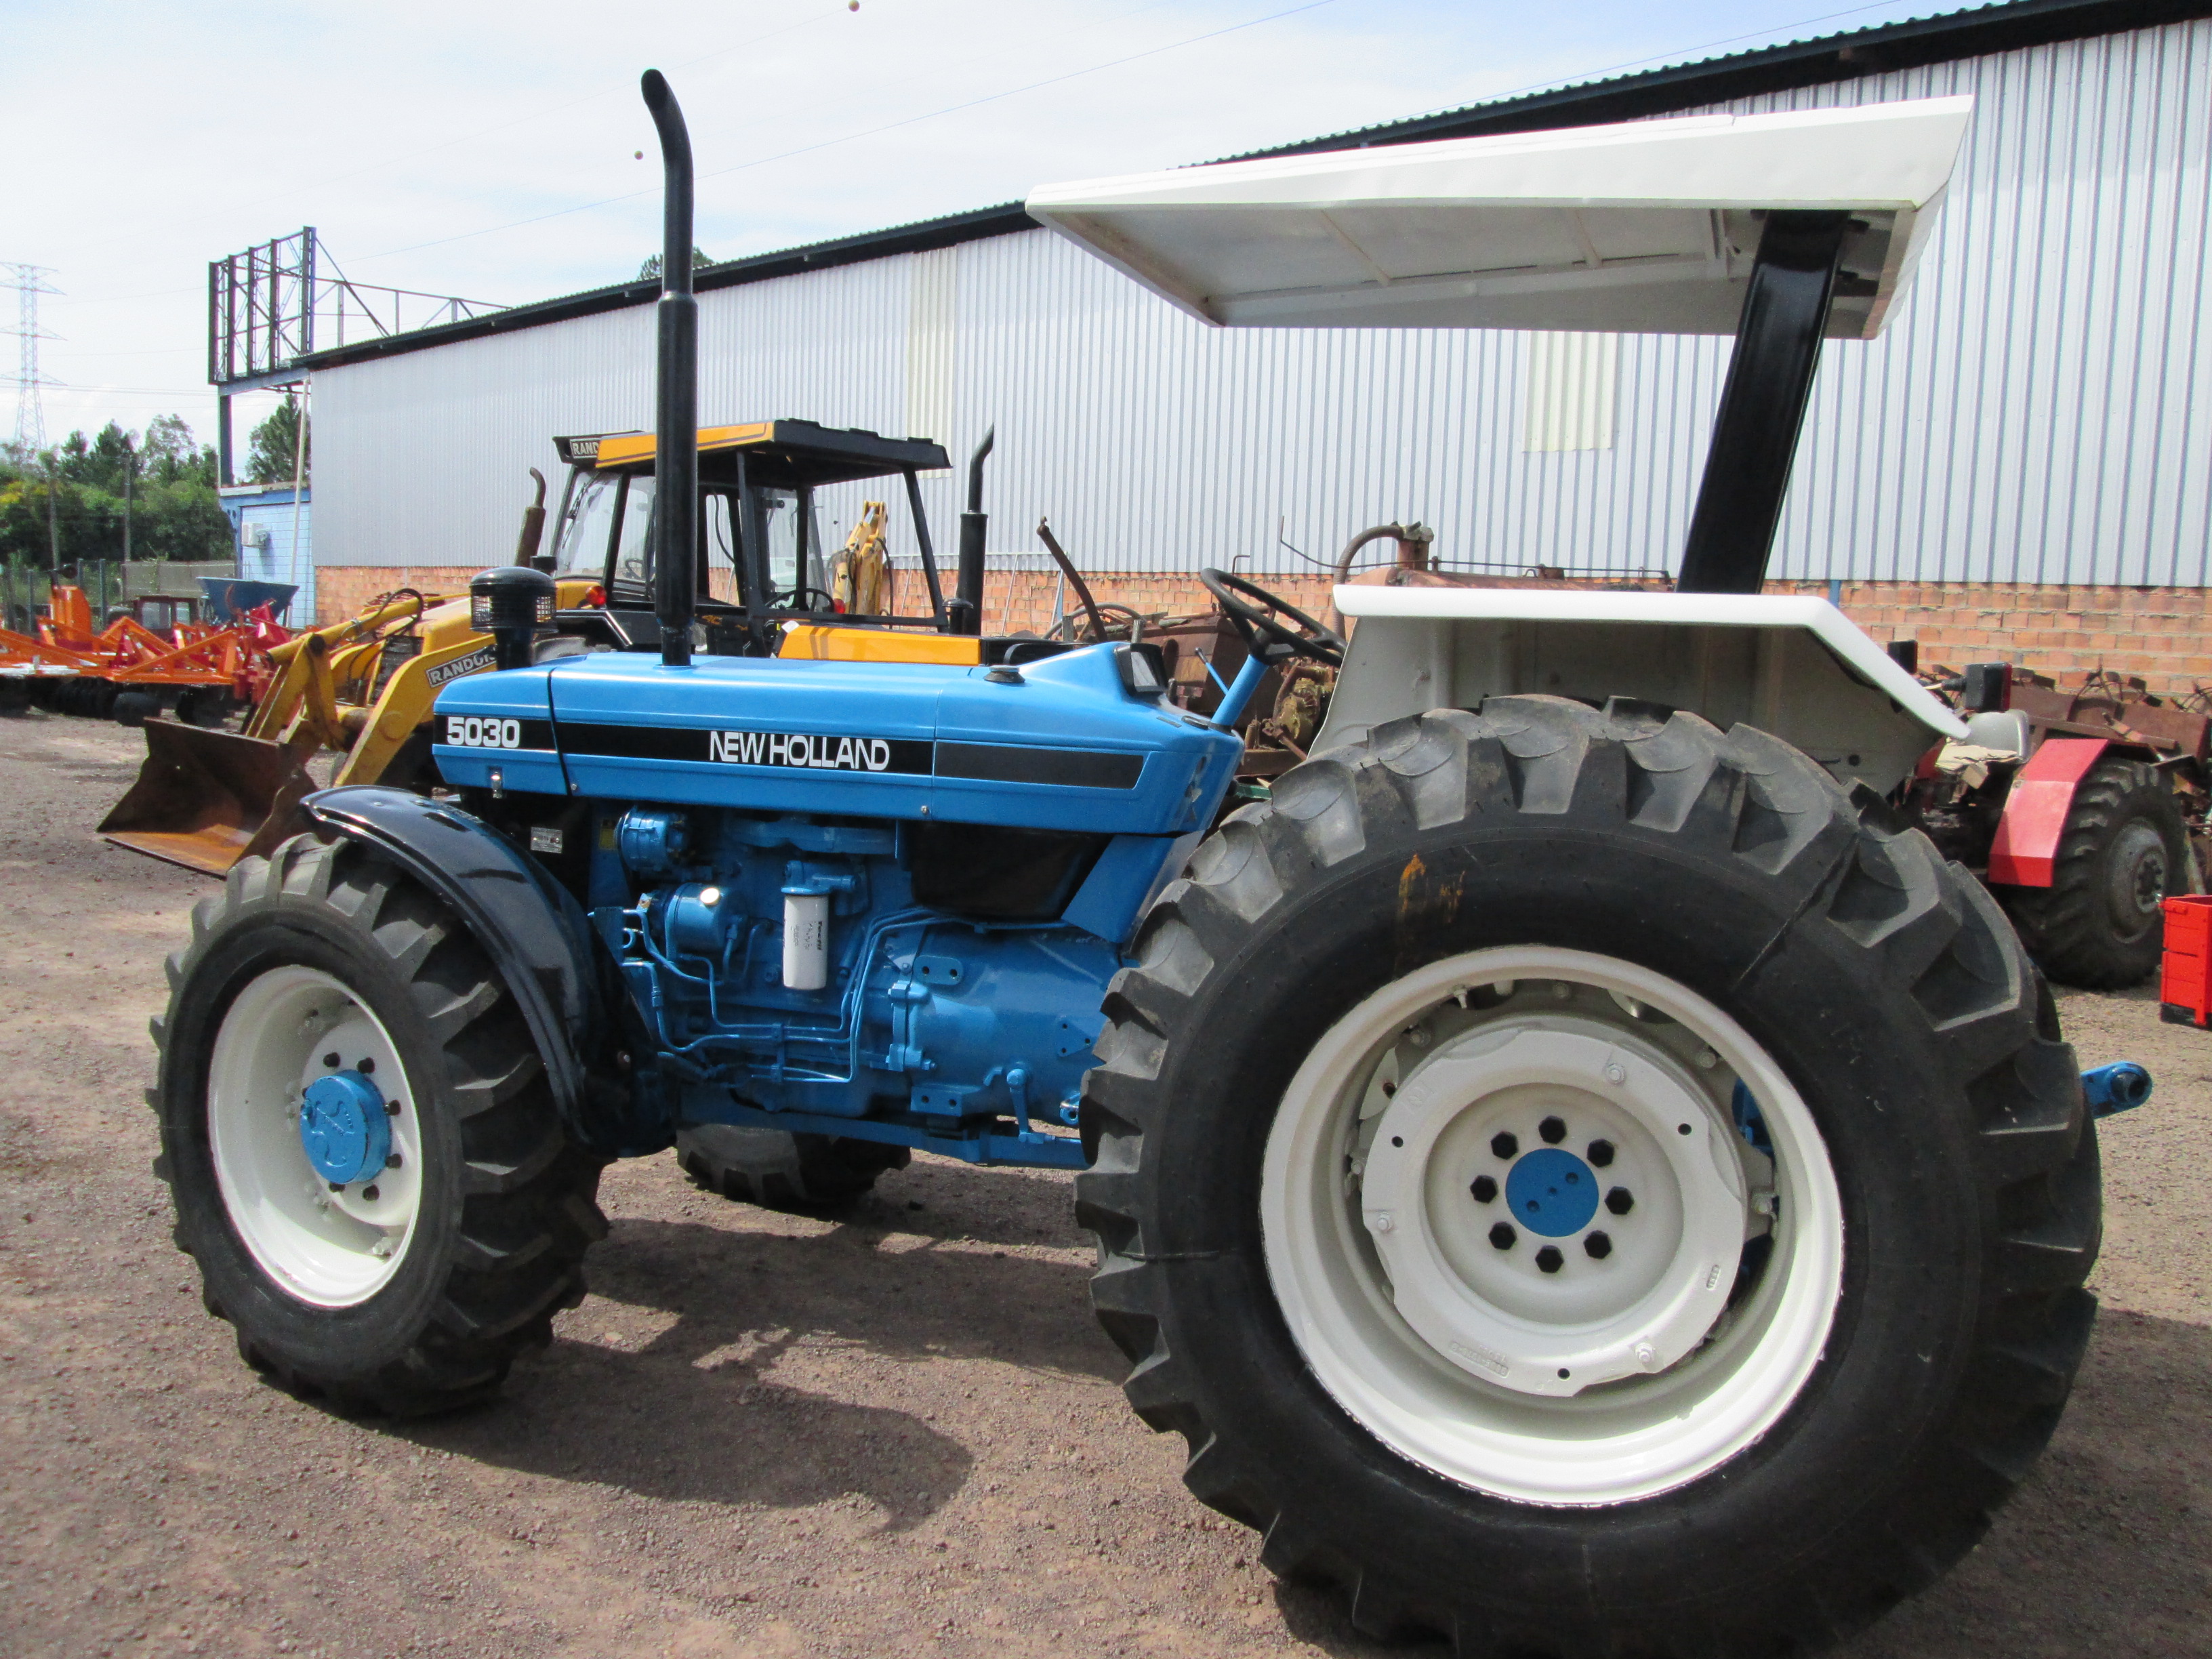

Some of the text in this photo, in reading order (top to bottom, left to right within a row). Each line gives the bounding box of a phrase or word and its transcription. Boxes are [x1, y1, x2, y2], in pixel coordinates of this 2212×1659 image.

[447, 716, 520, 748] 5030
[710, 731, 890, 771] NEW HOLLAND
